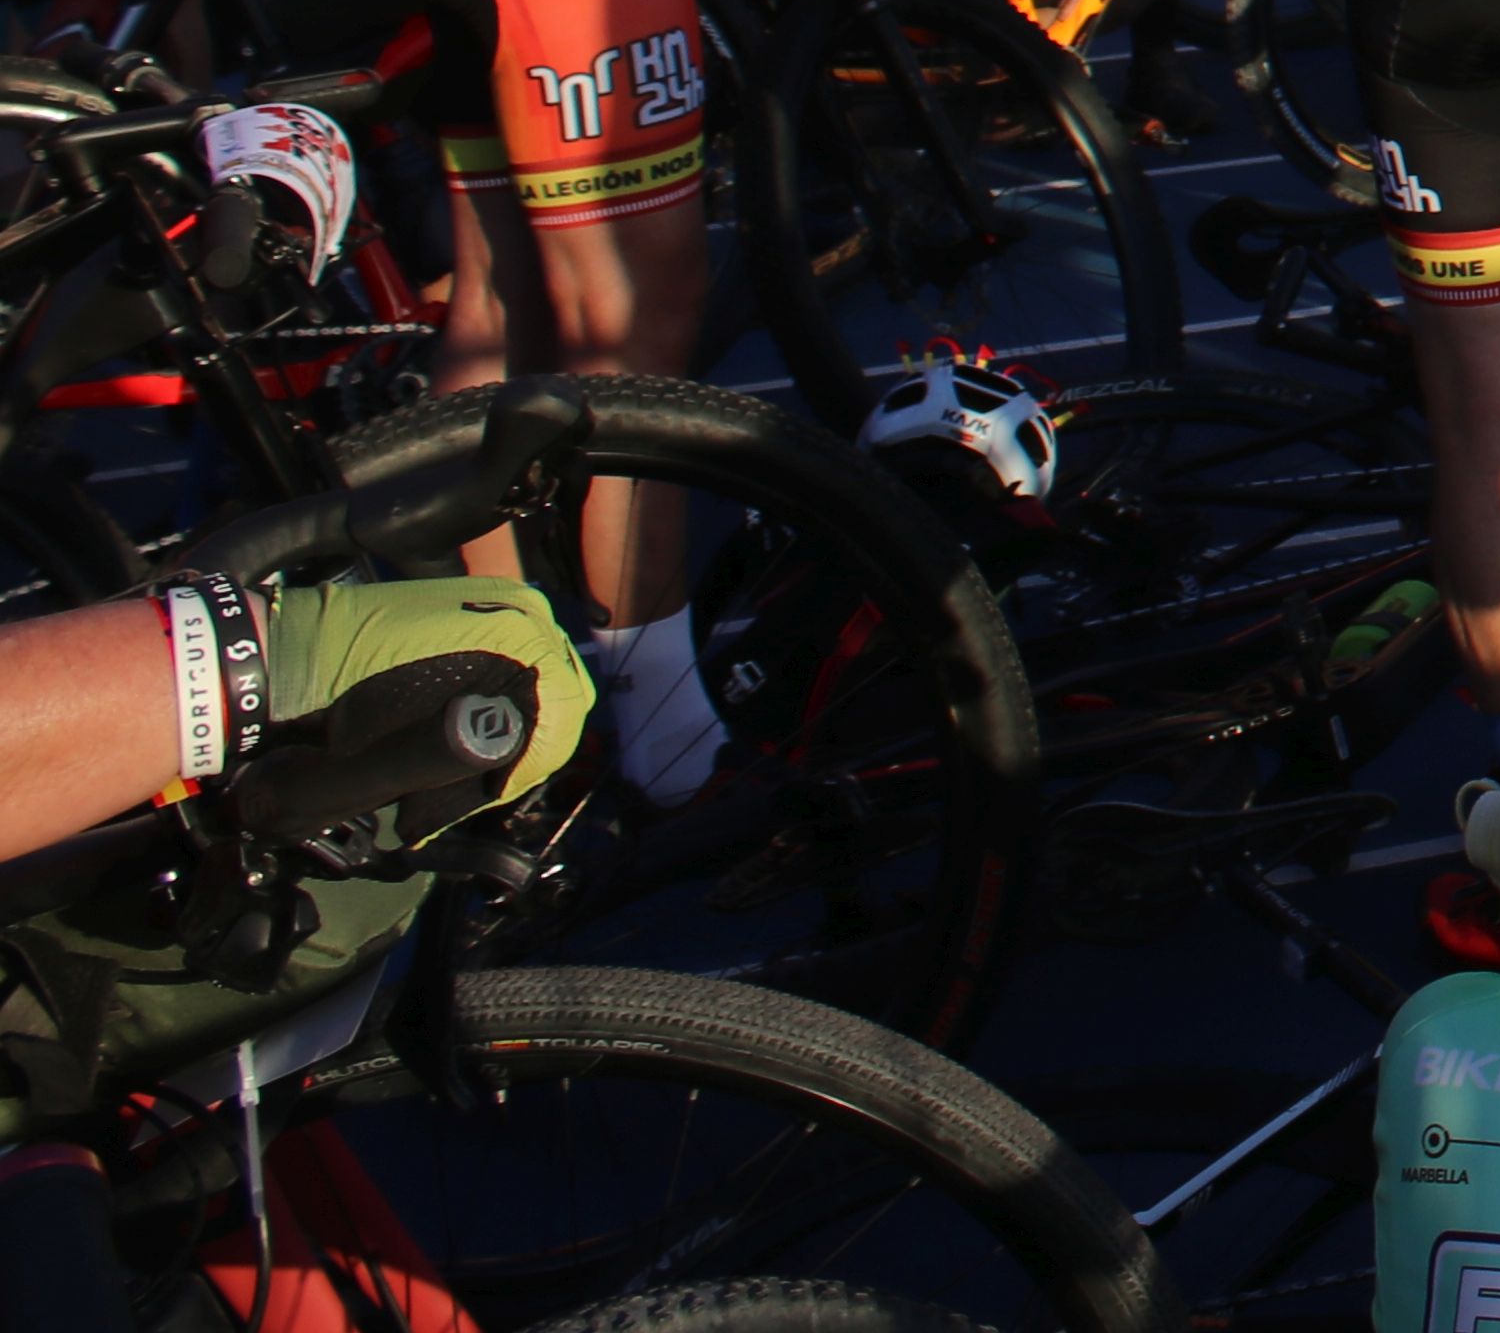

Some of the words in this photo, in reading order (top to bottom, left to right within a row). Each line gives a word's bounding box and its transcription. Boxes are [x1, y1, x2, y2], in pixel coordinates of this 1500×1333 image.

[542, 164, 647, 200] LEGIÓN
[1430, 259, 1487, 279] UNE
[1053, 376, 1173, 404] MEZCAL
[1401, 1165, 1469, 1186] MARBELLA
